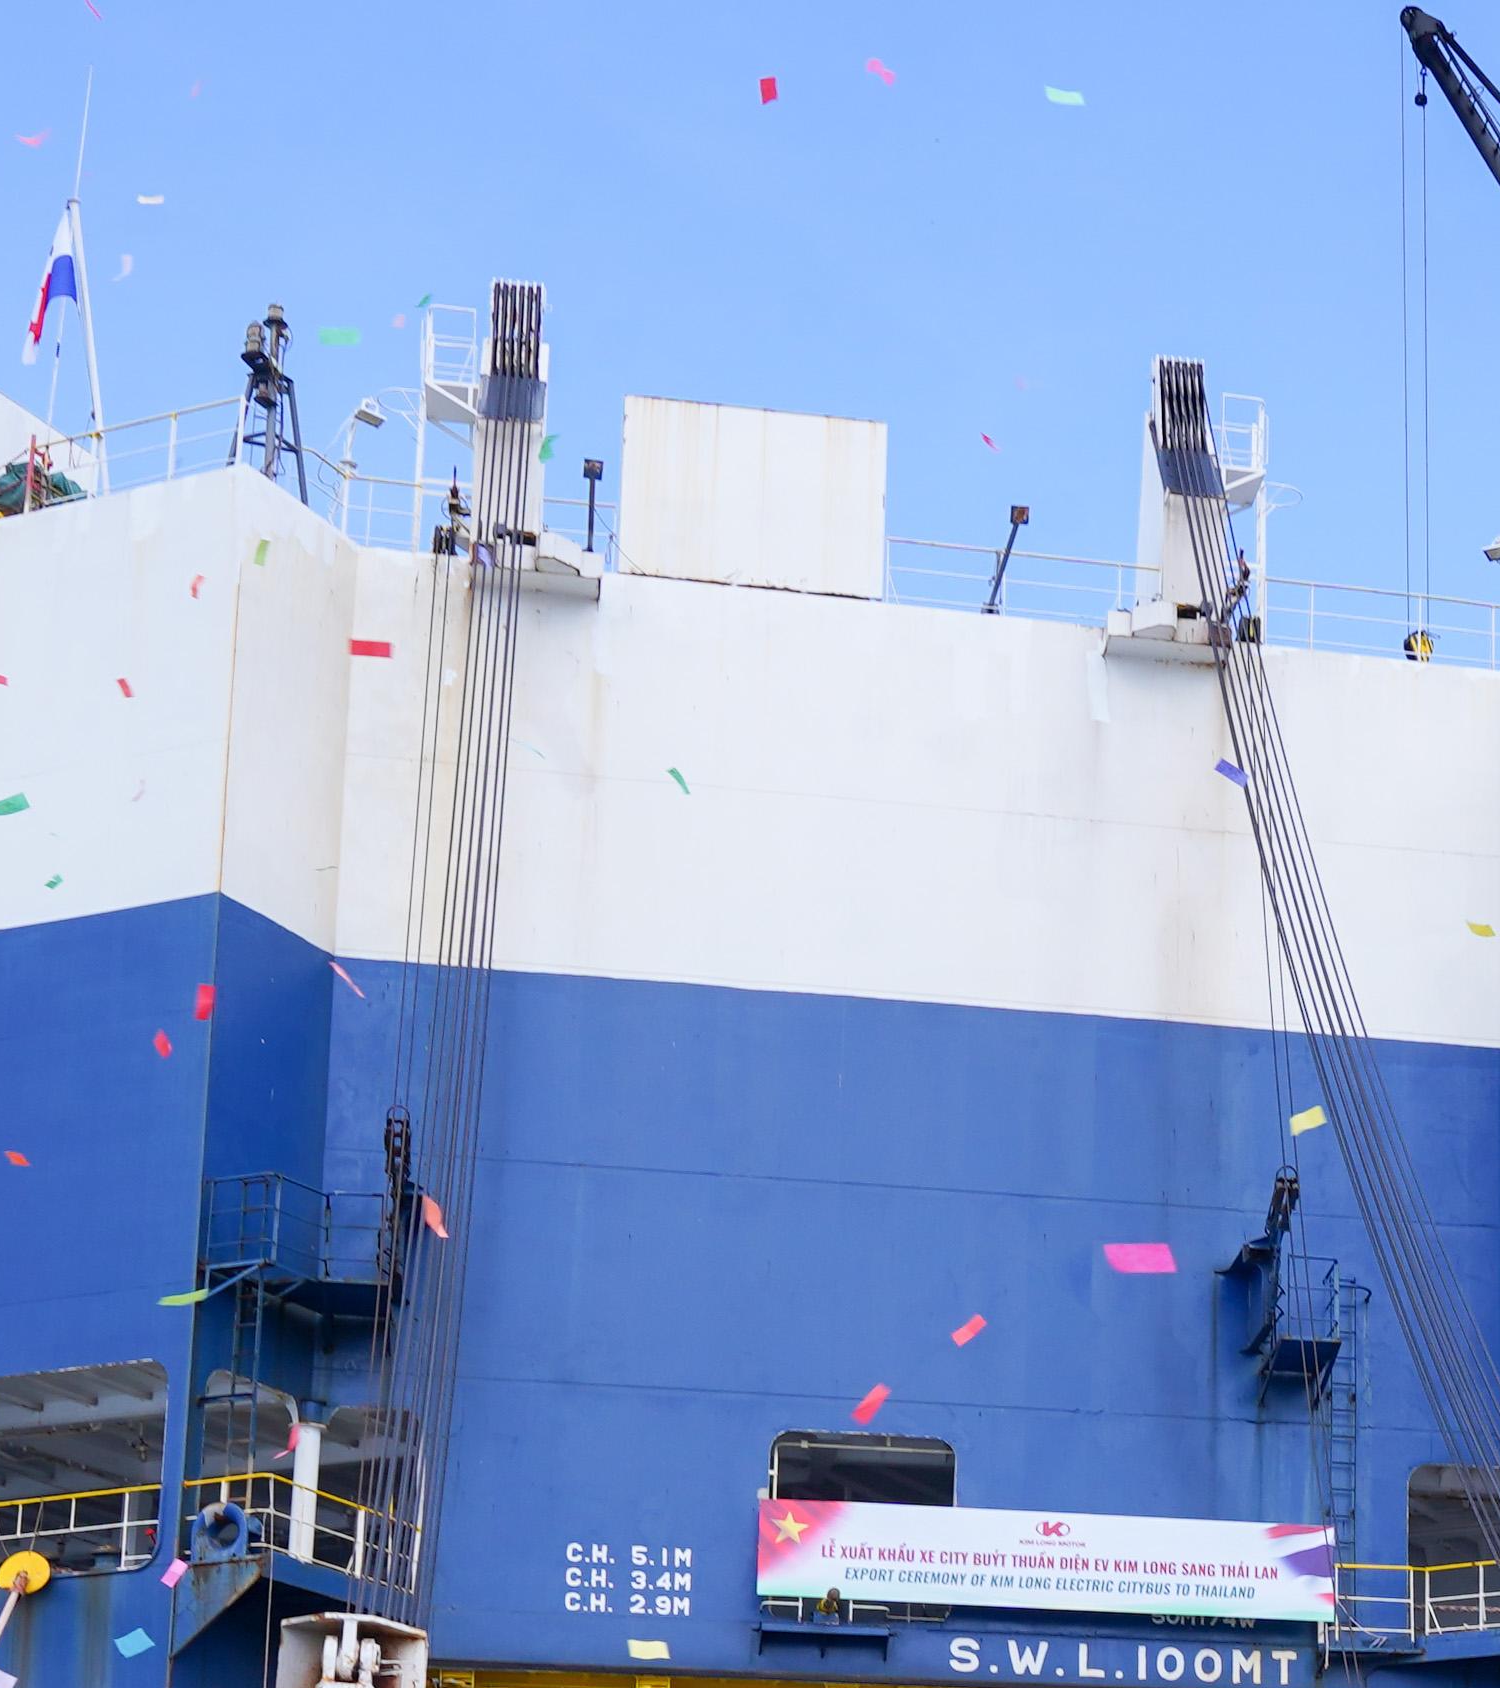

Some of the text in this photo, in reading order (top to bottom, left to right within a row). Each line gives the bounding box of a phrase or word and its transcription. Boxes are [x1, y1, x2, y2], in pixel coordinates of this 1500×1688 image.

[566, 1542, 615, 1564] C.H.
[919, 1550, 935, 1564] XE
[940, 1551, 968, 1566] CITY
[1094, 1558, 1110, 1572] EV
[1114, 1559, 1138, 1573] KIM
[1143, 1561, 1177, 1576] LONG
[1181, 1562, 1215, 1577] SANG
[1220, 1560, 1250, 1579] THÁI
[1254, 1566, 1278, 1579] LAN
[565, 1567, 692, 1591] C.H. 3.4M
[845, 1567, 1256, 1600] EXPORT CEREMONY OF KIM LONG ELECTRIC CITYBUS TO THAILAND
[564, 1591, 690, 1616] C.H. 2.9M
